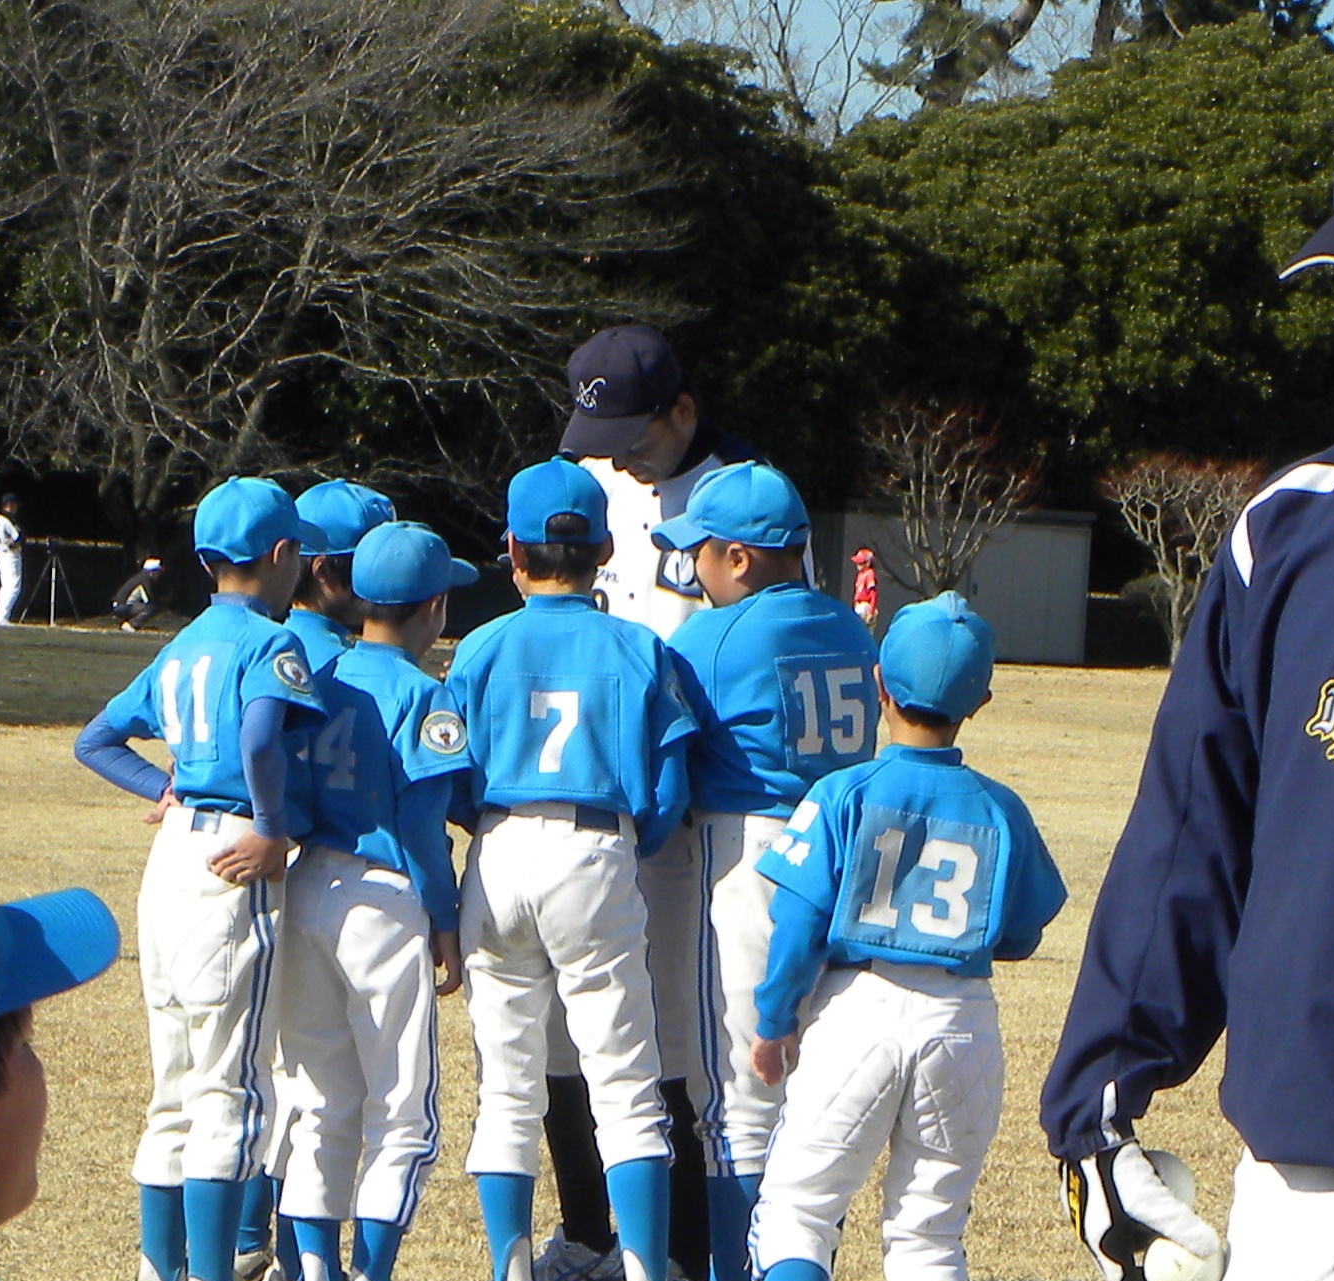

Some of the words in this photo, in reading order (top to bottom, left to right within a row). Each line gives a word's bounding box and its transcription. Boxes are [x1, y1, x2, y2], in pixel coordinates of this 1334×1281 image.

[160, 656, 211, 744] 11
[531, 691, 579, 773] 7
[793, 667, 865, 756] 15
[859, 828, 978, 939] 13
